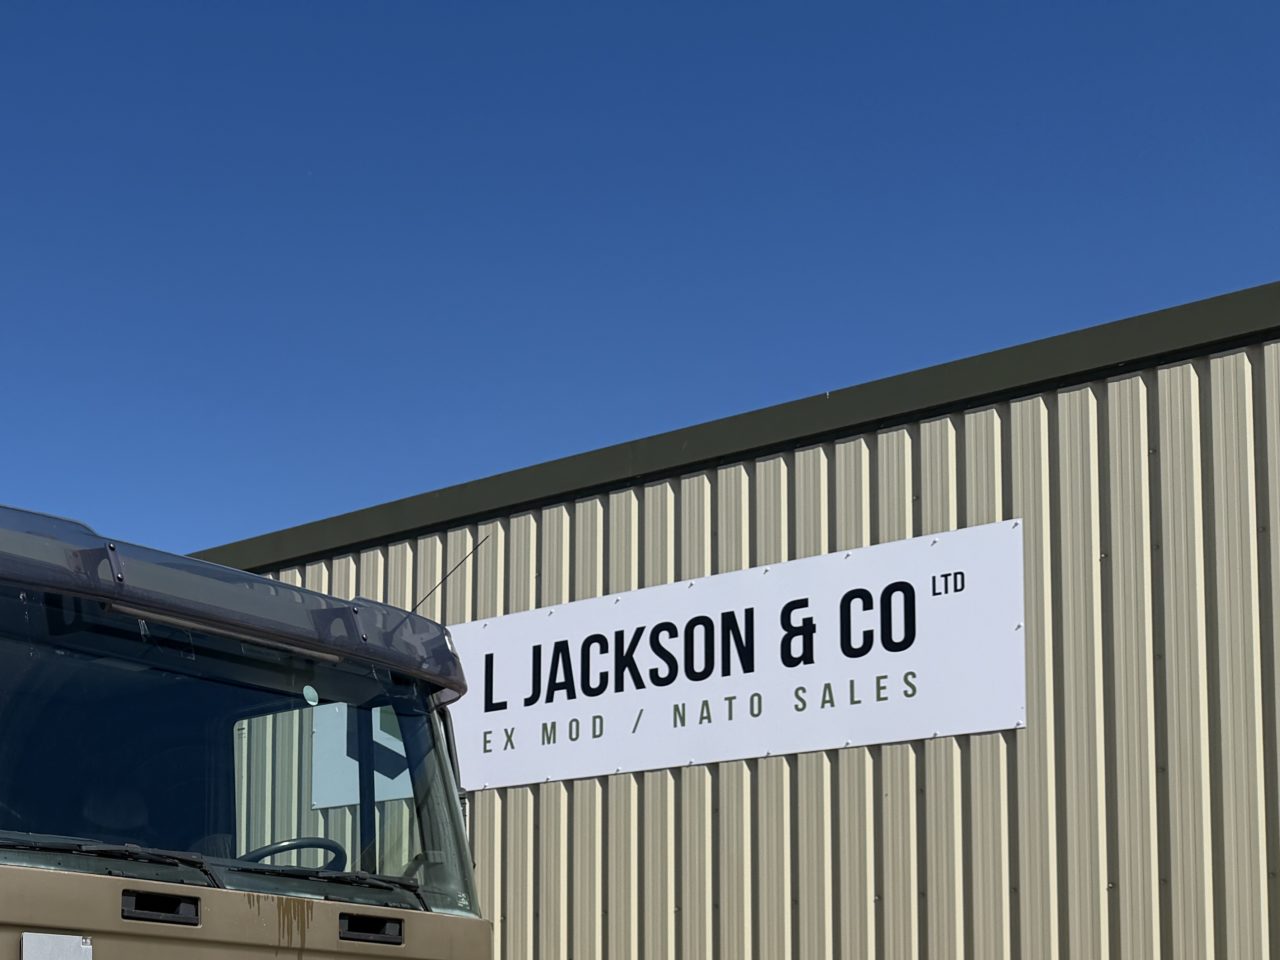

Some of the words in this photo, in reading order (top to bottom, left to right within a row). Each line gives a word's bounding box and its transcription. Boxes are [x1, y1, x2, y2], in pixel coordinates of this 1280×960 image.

[484, 653, 508, 713] L
[524, 607, 755, 708] JACKSON
[780, 597, 817, 668] &
[839, 581, 916, 658] CO
[932, 571, 965, 597] LTD
[483, 727, 515, 754] EX
[541, 714, 604, 746] MOD
[631, 708, 644, 734] /
[673, 692, 763, 728] NATO
[794, 671, 917, 712] SALES
